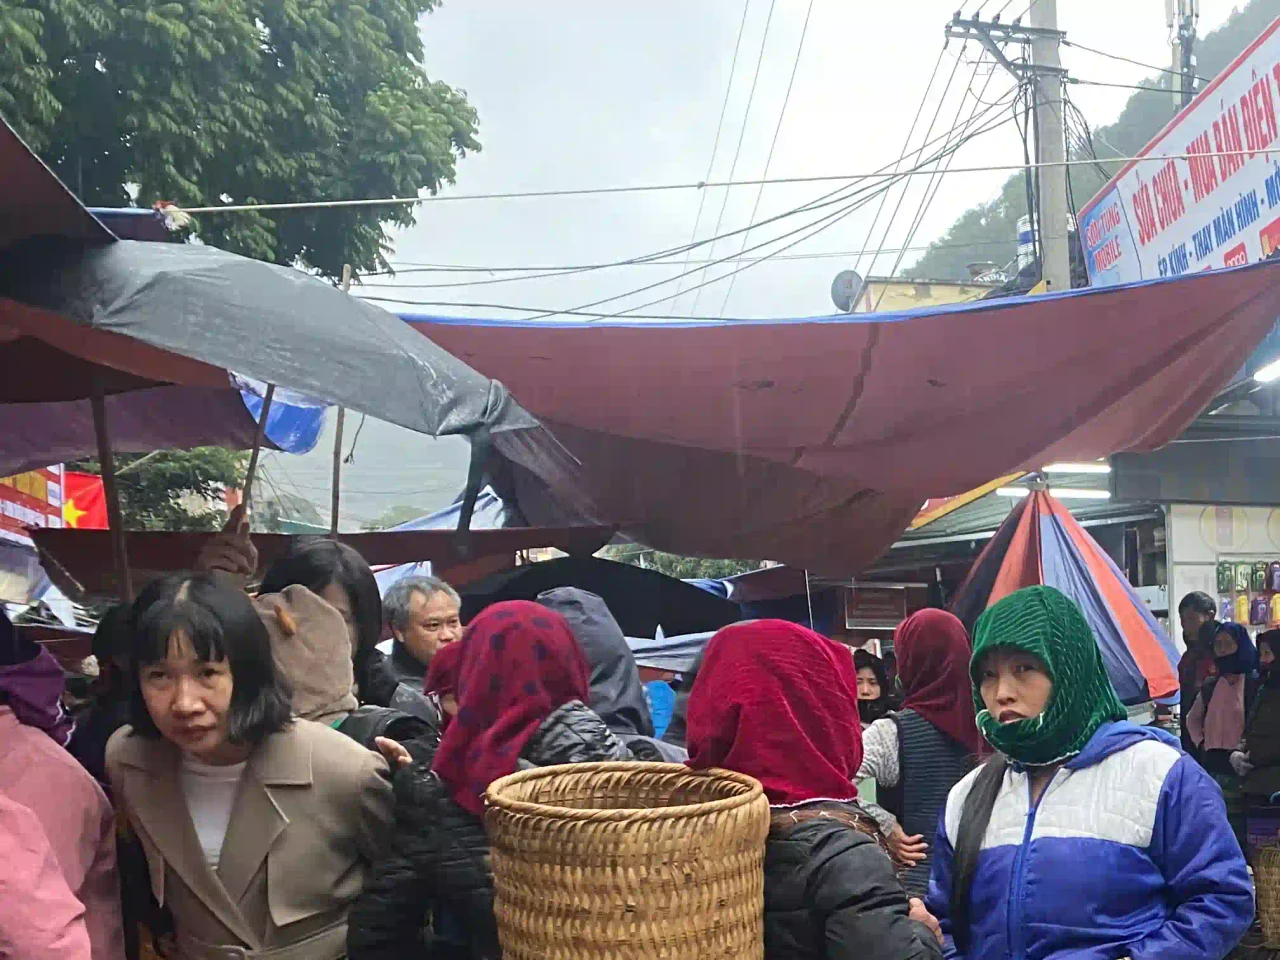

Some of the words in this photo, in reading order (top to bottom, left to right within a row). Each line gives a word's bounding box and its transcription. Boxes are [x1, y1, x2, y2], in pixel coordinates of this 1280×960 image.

[1186, 130, 1218, 204] MUA
[1094, 234, 1122, 272] MOBILE
[1168, 242, 1189, 276] KÍNH
[1192, 223, 1214, 261] THAY
[1213, 206, 1236, 248] MÀN
[1234, 188, 1261, 232] HÌNH
